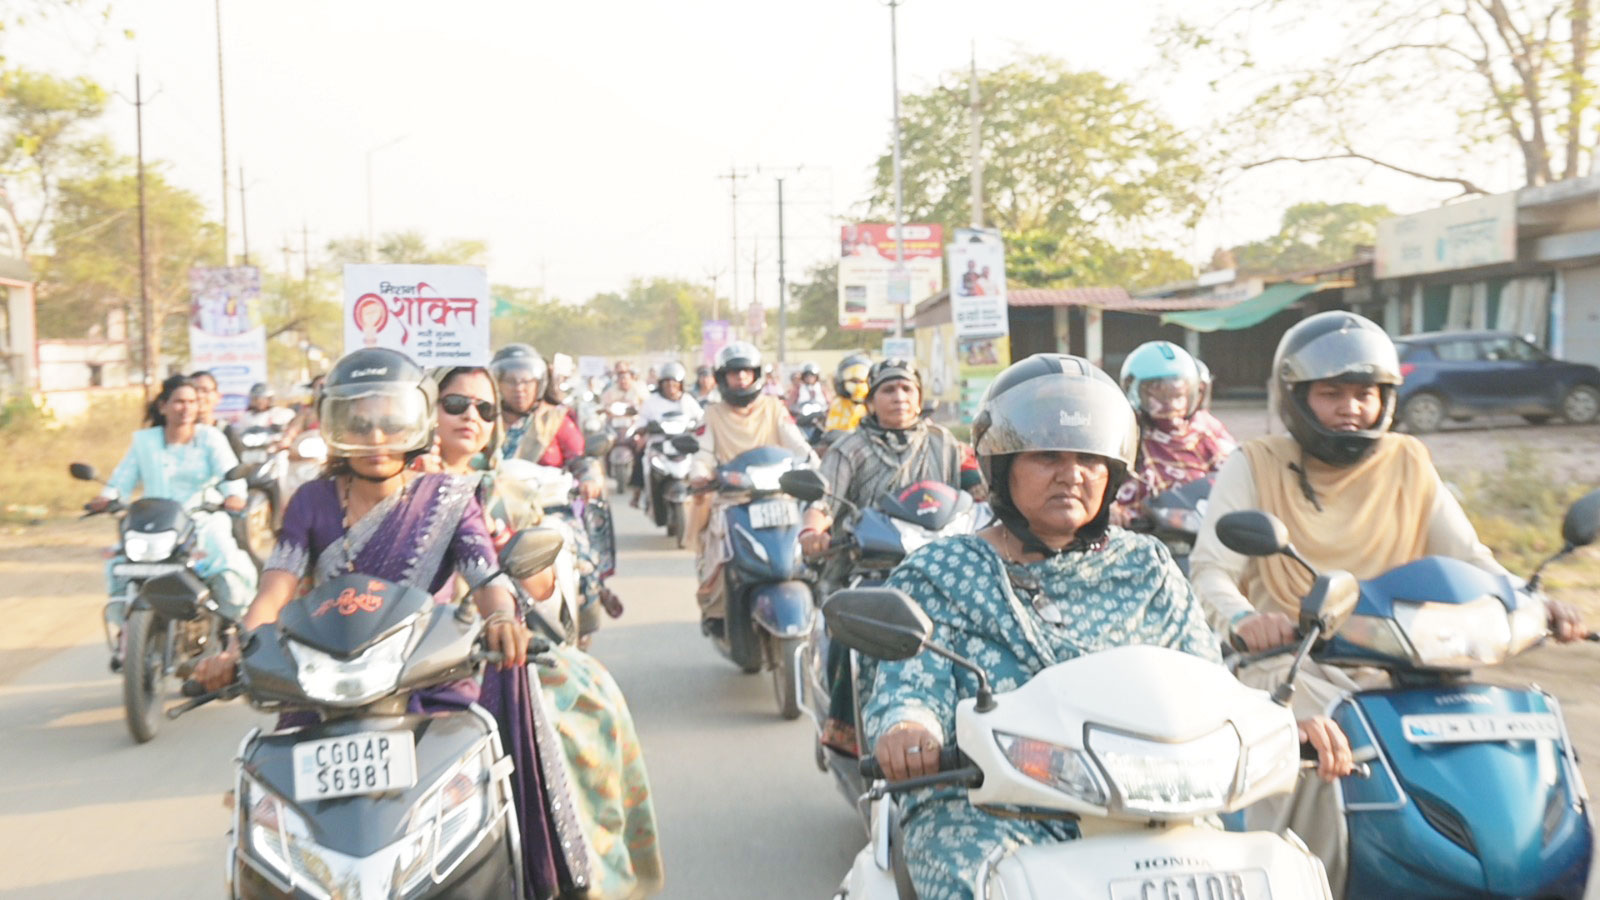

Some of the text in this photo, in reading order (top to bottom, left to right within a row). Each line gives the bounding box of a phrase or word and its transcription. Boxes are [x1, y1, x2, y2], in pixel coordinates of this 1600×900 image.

[380, 281, 415, 295] मिशन
[388, 282, 478, 346] शक्ति
[315, 737, 390, 768] CG04P
[316, 764, 390, 794] S6981
